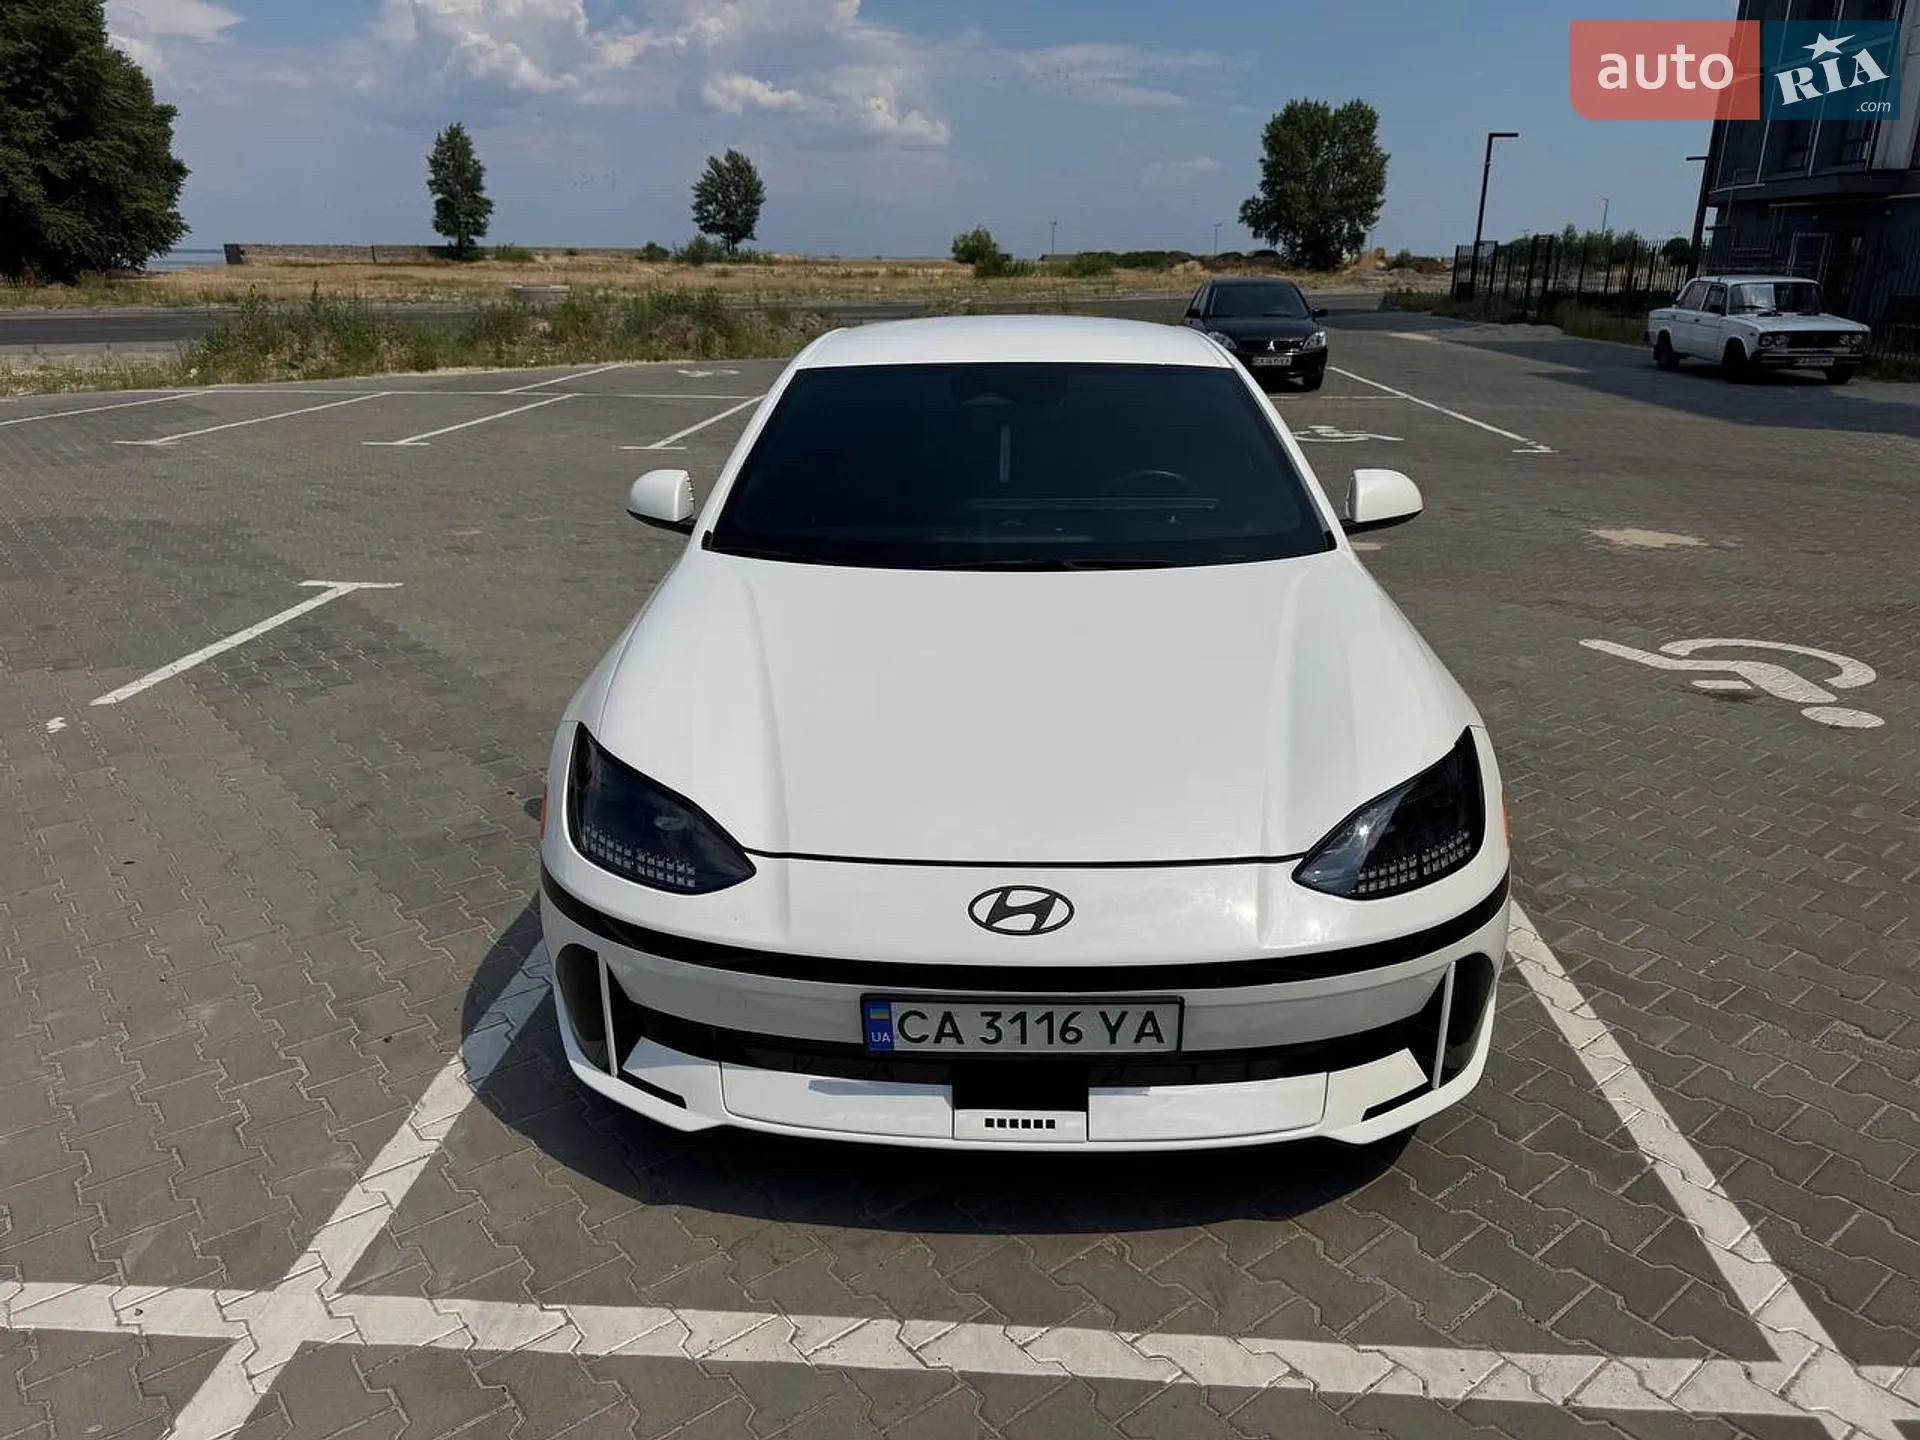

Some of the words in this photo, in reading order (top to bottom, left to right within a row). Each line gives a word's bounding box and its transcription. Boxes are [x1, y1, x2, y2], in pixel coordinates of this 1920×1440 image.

[871, 1031, 891, 1042] UA
[898, 1010, 964, 1044] CA
[979, 1011, 1083, 1045] 3116
[1100, 1011, 1165, 1045] YA
